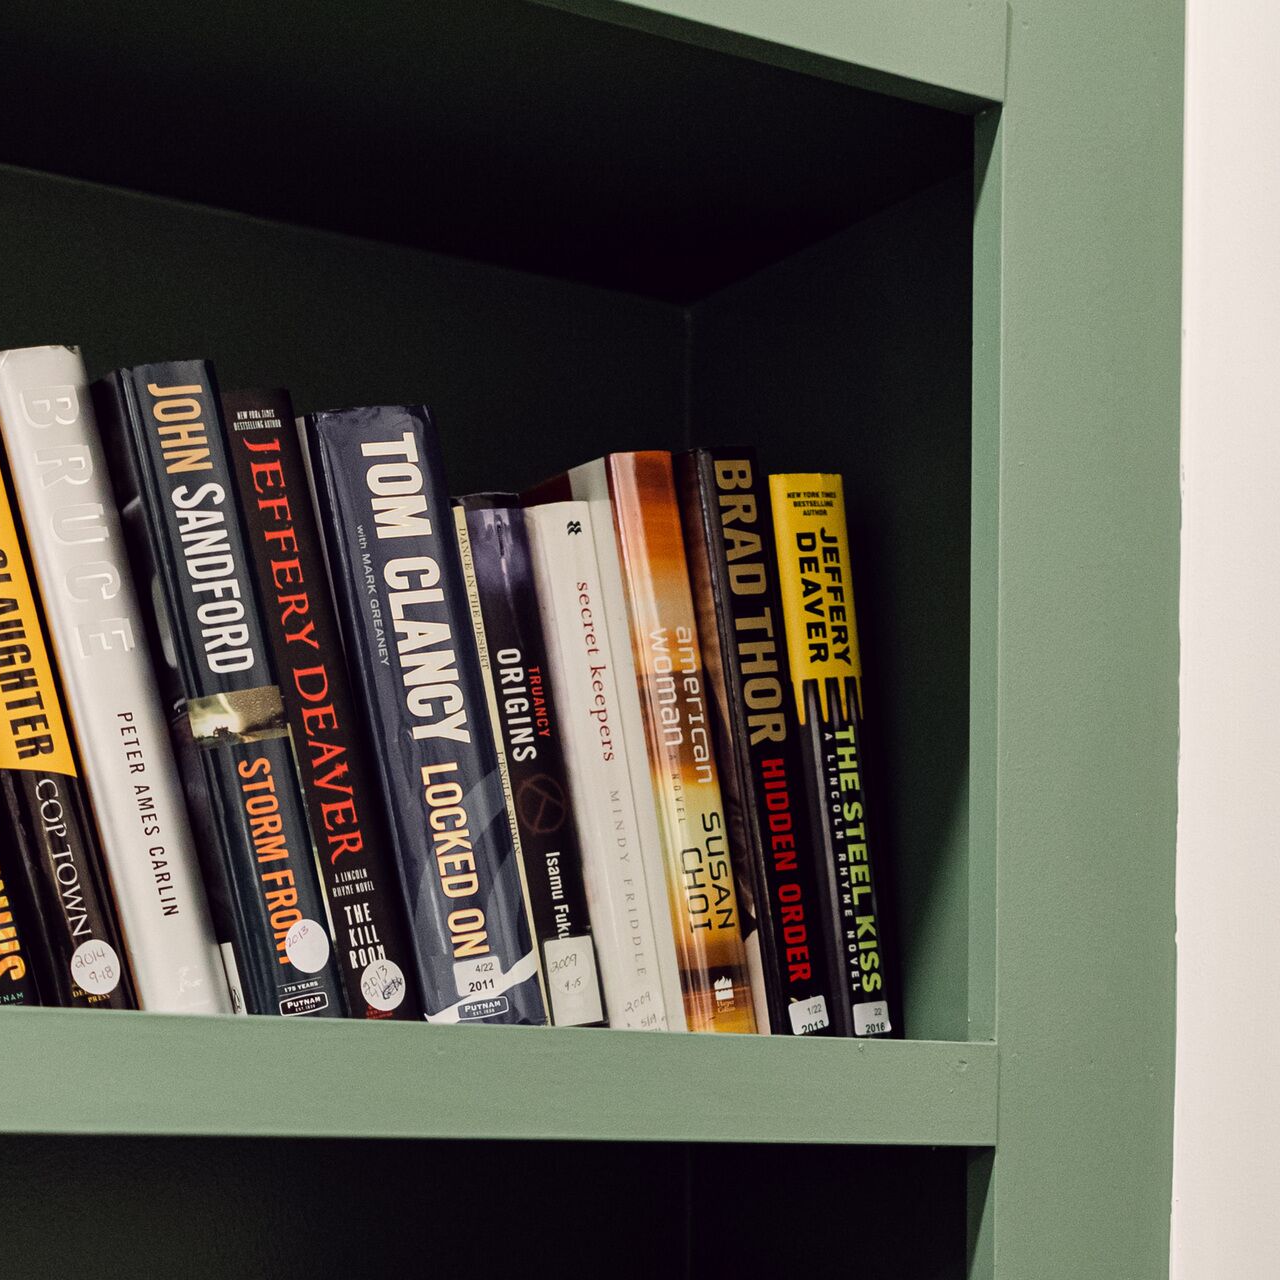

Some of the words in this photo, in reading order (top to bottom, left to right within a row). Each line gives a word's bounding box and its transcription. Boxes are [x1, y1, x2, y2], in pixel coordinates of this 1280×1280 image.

[147, 384, 213, 475] JOHN
[20, 383, 136, 658] BRUCE
[360, 432, 432, 539] TOM
[713, 459, 768, 596] BRAD
[171, 482, 255, 674] SANDFORD
[459, 528, 473, 570] DANCE
[467, 575, 475, 588] IN
[356, 524, 368, 550] with
[362, 553, 377, 595] MARK
[370, 599, 390, 666] GREANEY
[470, 591, 480, 617] THE
[795, 531, 829, 665] DEAVER
[819, 526, 852, 667] JEFFERY
[243, 437, 321, 651] JEFFERY
[292, 663, 365, 865] DEAVER
[383, 556, 471, 744] CLANCY
[475, 622, 490, 669] DESERT
[576, 581, 601, 656] secret
[590, 664, 615, 763] keepers
[648, 627, 683, 747] woman
[734, 607, 787, 747] THOR
[496, 648, 537, 762] ORIGINS
[527, 666, 551, 738] TRUANCY
[675, 625, 714, 785] american
[824, 732, 833, 742] A
[672, 774, 686, 823] NOVEL
[826, 755, 844, 840] LINCOLN
[834, 725, 860, 793] THE
[117, 711, 146, 774] PETER
[133, 785, 160, 837] AMES
[148, 846, 180, 917] CARLIN
[237, 757, 289, 864] STORM
[420, 762, 479, 899] LOCKED
[761, 758, 798, 872] HIDDEN
[842, 801, 872, 906] STEEL
[35, 778, 67, 838] COP
[52, 844, 93, 938] TOWN
[332, 884, 354, 897] RHYME
[355, 881, 374, 893] NOVEL
[335, 873, 339, 883] A
[340, 868, 367, 882] LINCOLN
[545, 851, 564, 909] Isamu
[608, 790, 630, 865] MINDY
[624, 877, 647, 977] FRIDDLE
[680, 847, 712, 933] CHOI
[700, 811, 736, 930] SUSAN
[838, 853, 854, 918] RHYME
[344, 902, 372, 926] THE
[348, 924, 380, 948] KILL
[446, 907, 490, 959] ON
[777, 883, 812, 984] ORDER
[855, 914, 882, 993] KISS
[287, 996, 321, 1009] PUTNAM
[298, 981, 318, 990] YEARS
[469, 979, 495, 992] 2011
[475, 962, 494, 972] 4/22
[550, 953, 577, 973] 2009
[846, 930, 861, 991] NOVEL
[465, 1000, 501, 1013] PUTNAM
